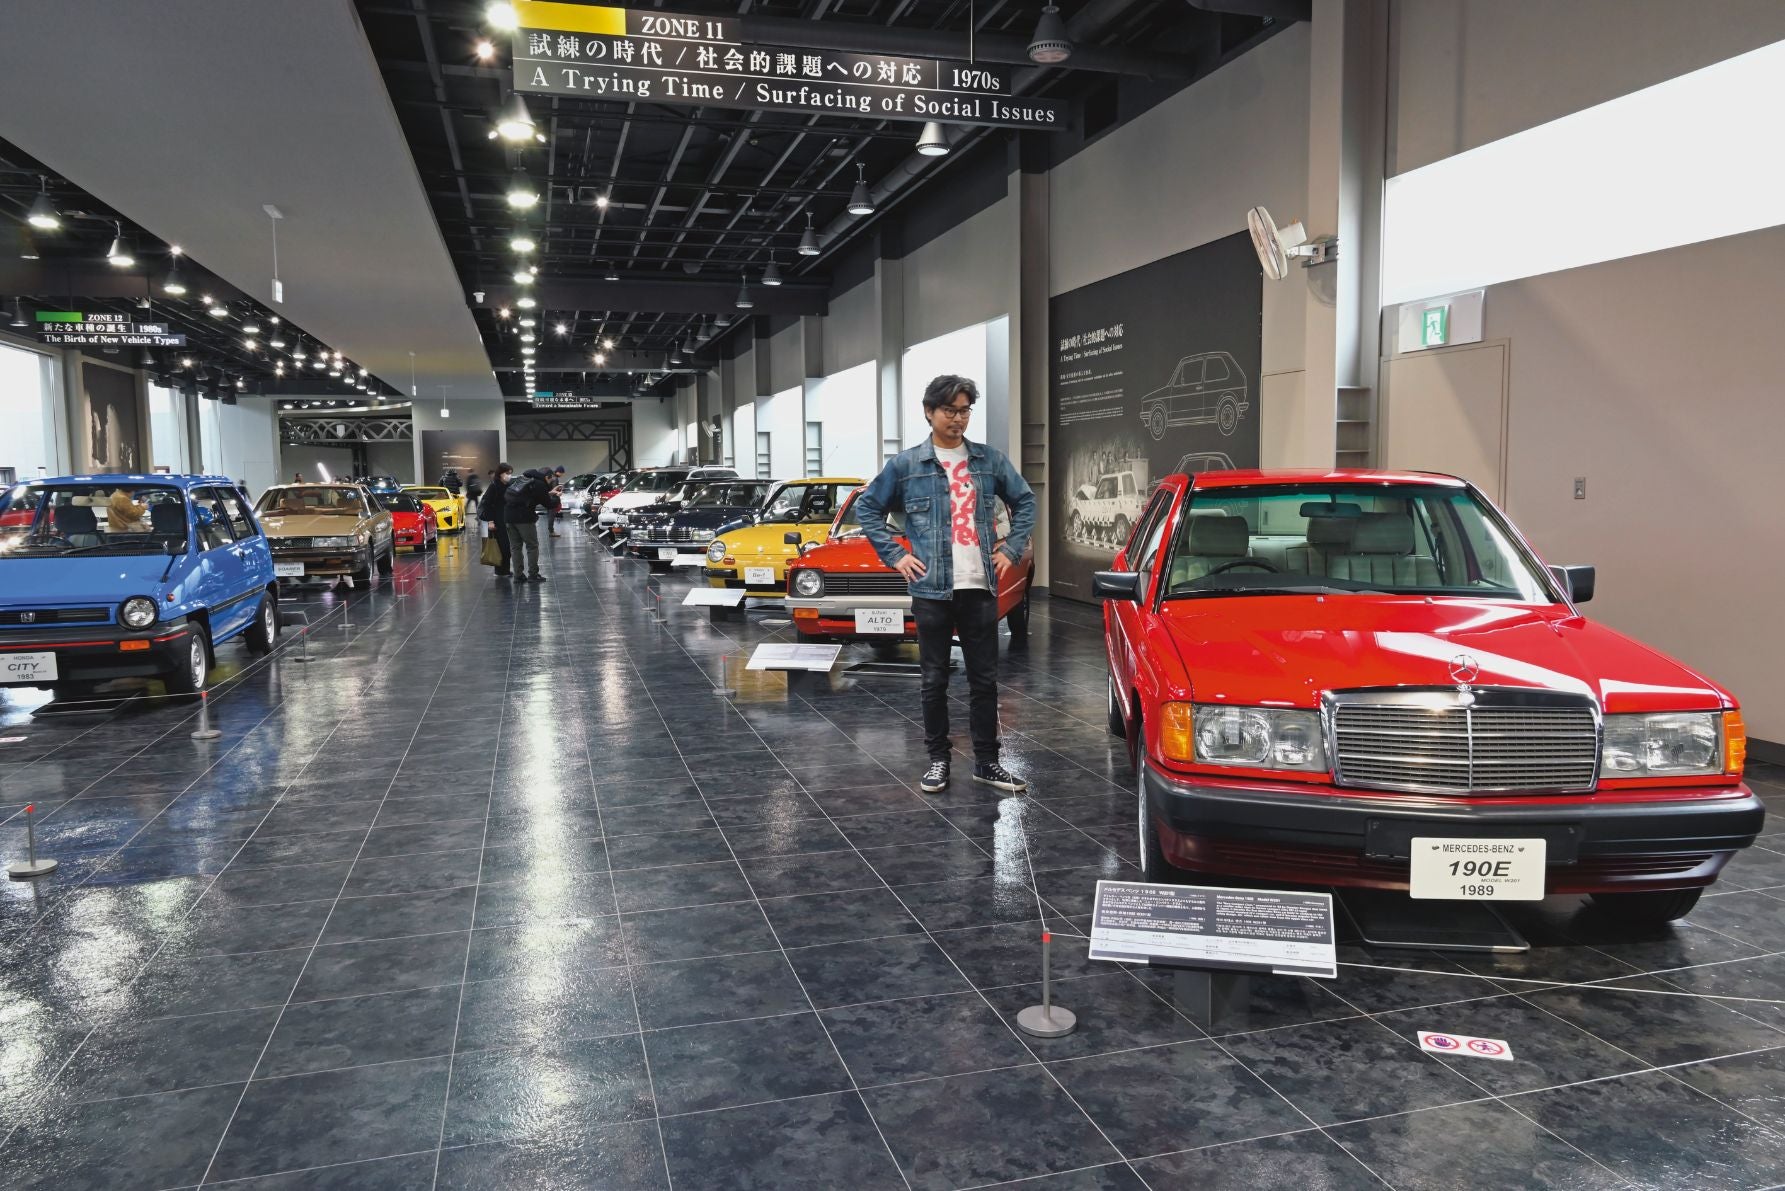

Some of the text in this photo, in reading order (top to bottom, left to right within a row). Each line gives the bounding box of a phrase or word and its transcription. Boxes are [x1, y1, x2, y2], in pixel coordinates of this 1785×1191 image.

[641, 16, 725, 40] ZONE 11
[528, 33, 663, 66] 試練の時代
[696, 46, 922, 85] 社会的課題への対応
[952, 69, 1000, 90] 1970s
[530, 67, 550, 87] A
[562, 69, 651, 97] Trying
[662, 76, 724, 99] Time
[756, 83, 872, 112] Surfacing
[882, 93, 905, 112] of
[914, 95, 981, 117] Social
[991, 102, 1055, 122] Issues
[88, 314, 123, 322] ZONE 12
[139, 324, 162, 333] 1980s
[45, 334, 180, 345] The Birth of New Vehicle Types
[7, 662, 40, 672] CITY
[1442, 844, 1514, 854] MERCEDES-BENZ
[1448, 860, 1512, 877] 190E
[1460, 884, 1495, 896] 1989
